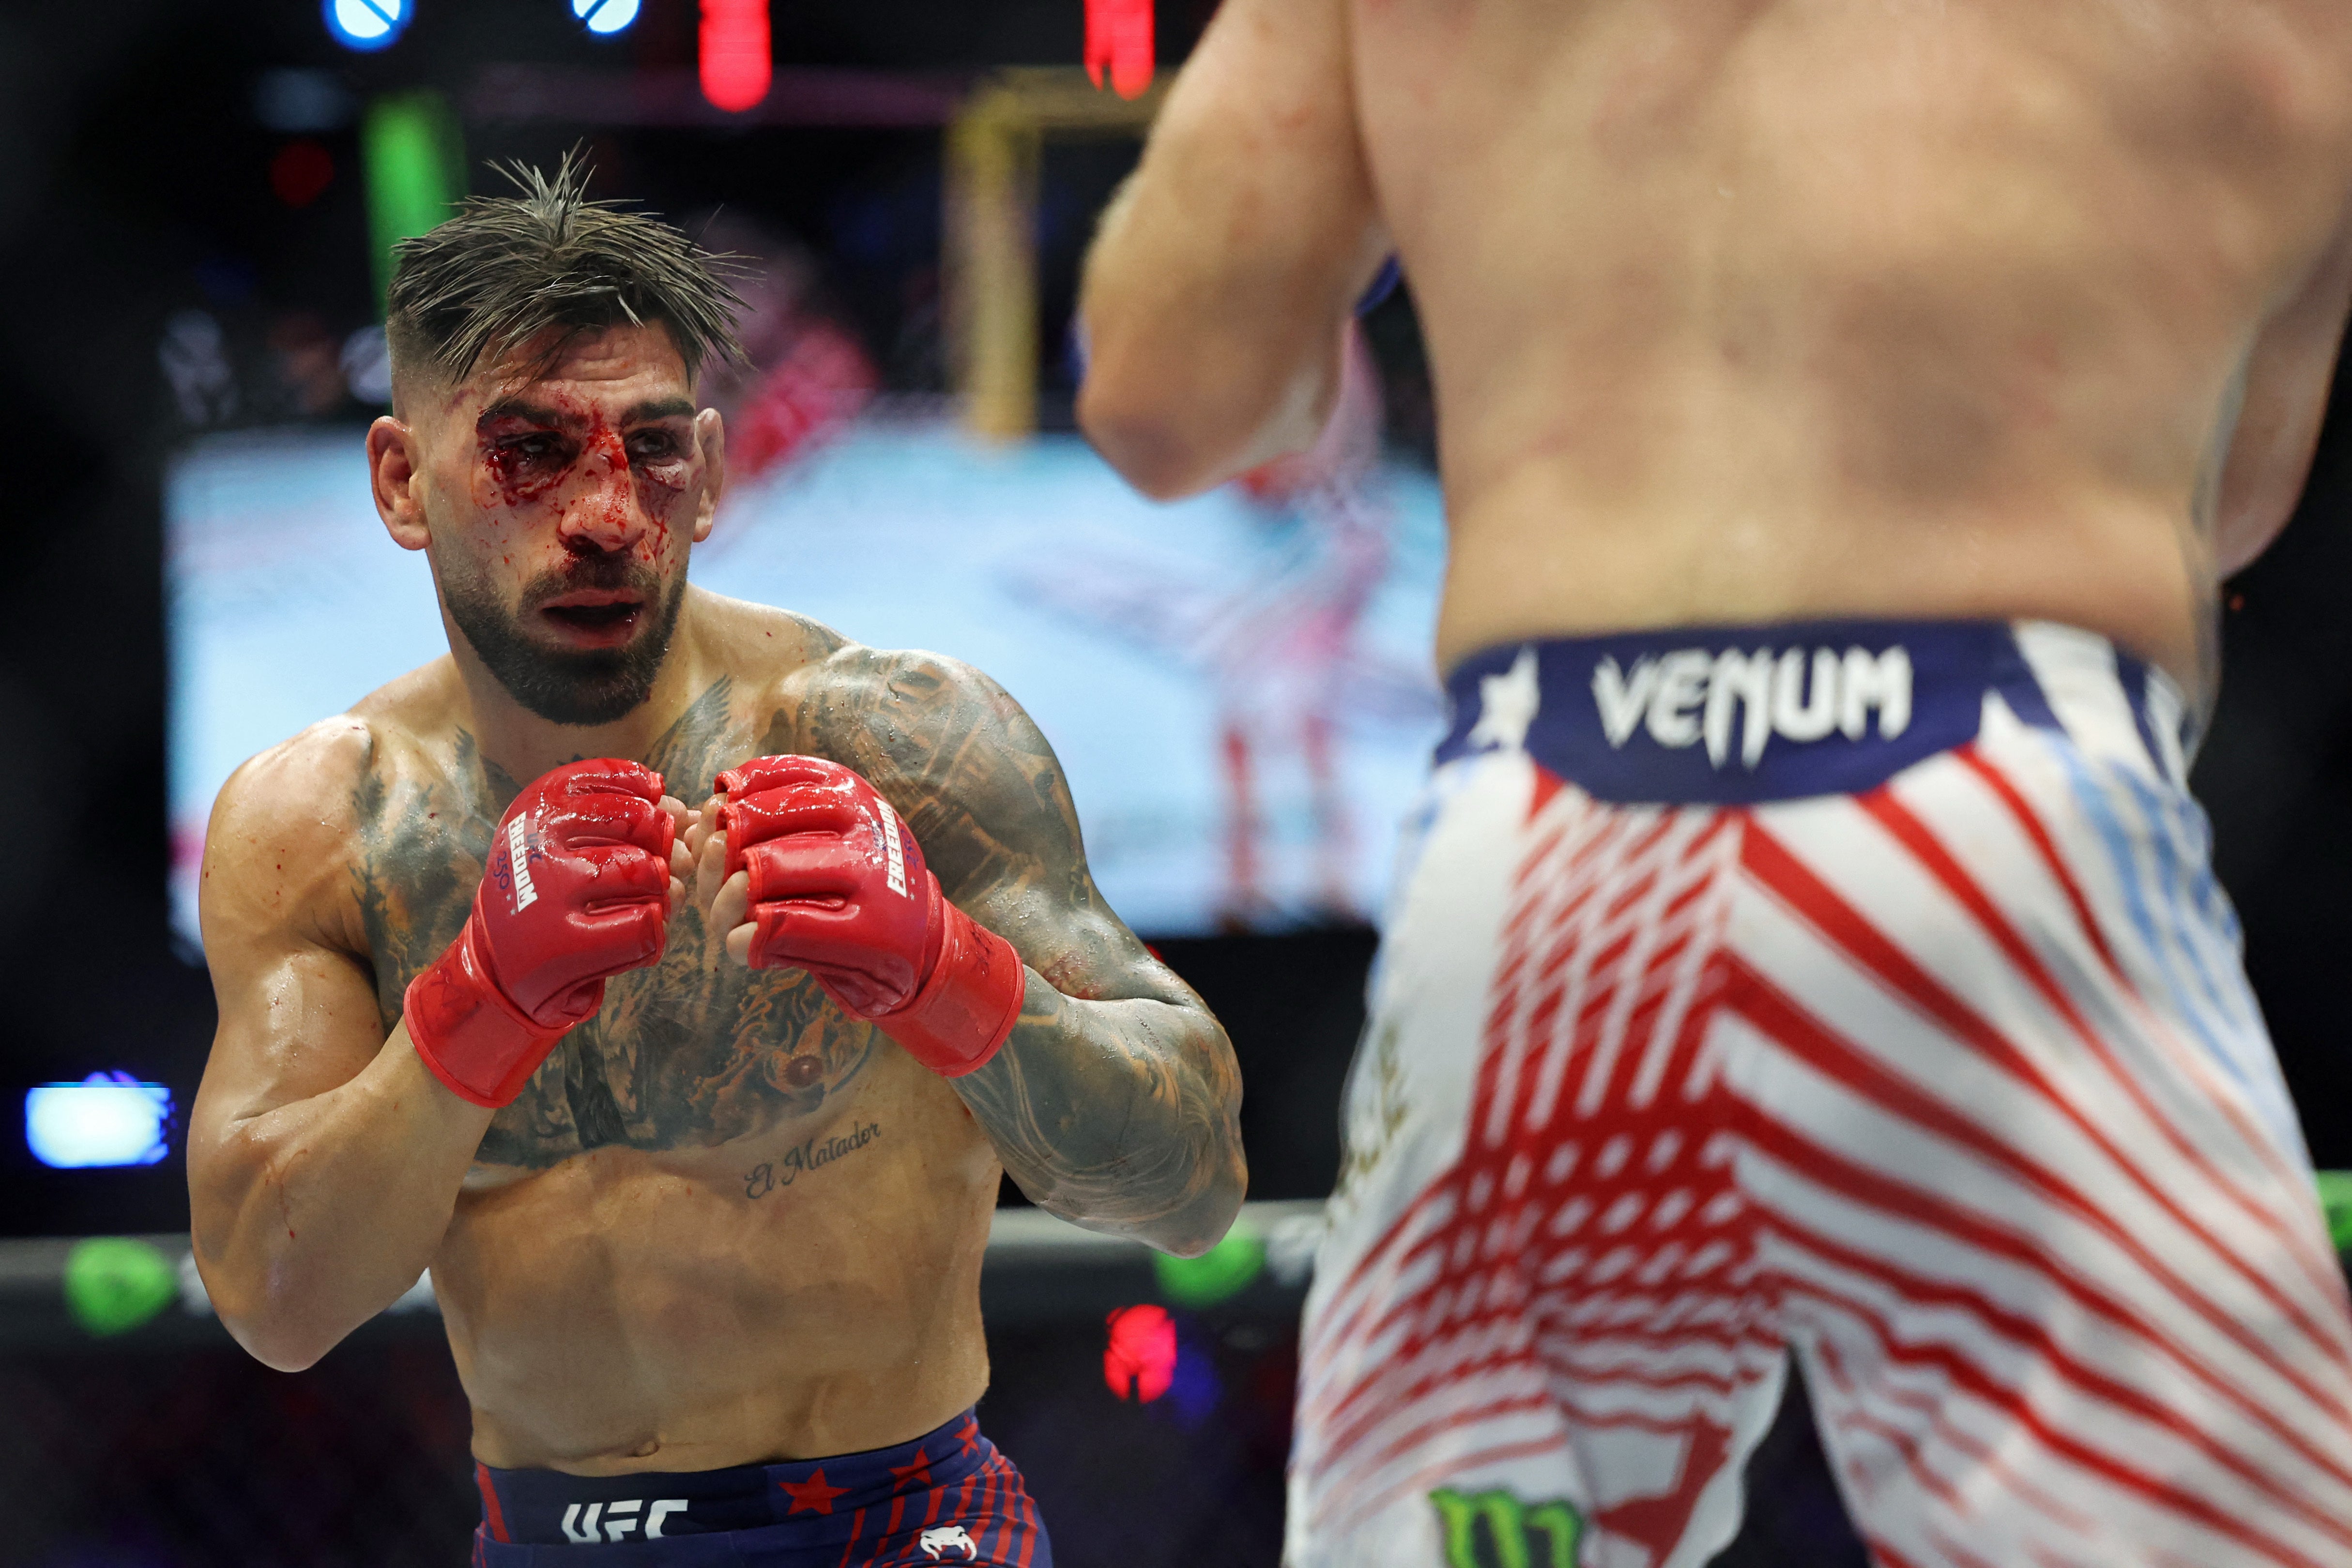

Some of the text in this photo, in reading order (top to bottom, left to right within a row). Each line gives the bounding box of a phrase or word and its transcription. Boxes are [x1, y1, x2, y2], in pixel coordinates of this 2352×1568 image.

[1590, 644, 1914, 772] VENUM
[494, 851, 510, 889] 250
[508, 811, 538, 913] FREEDOM
[873, 796, 907, 898] FREEDOM
[901, 829, 919, 870] 250
[744, 1120, 881, 1199] El Matador
[561, 1499, 688, 1543] UFC
